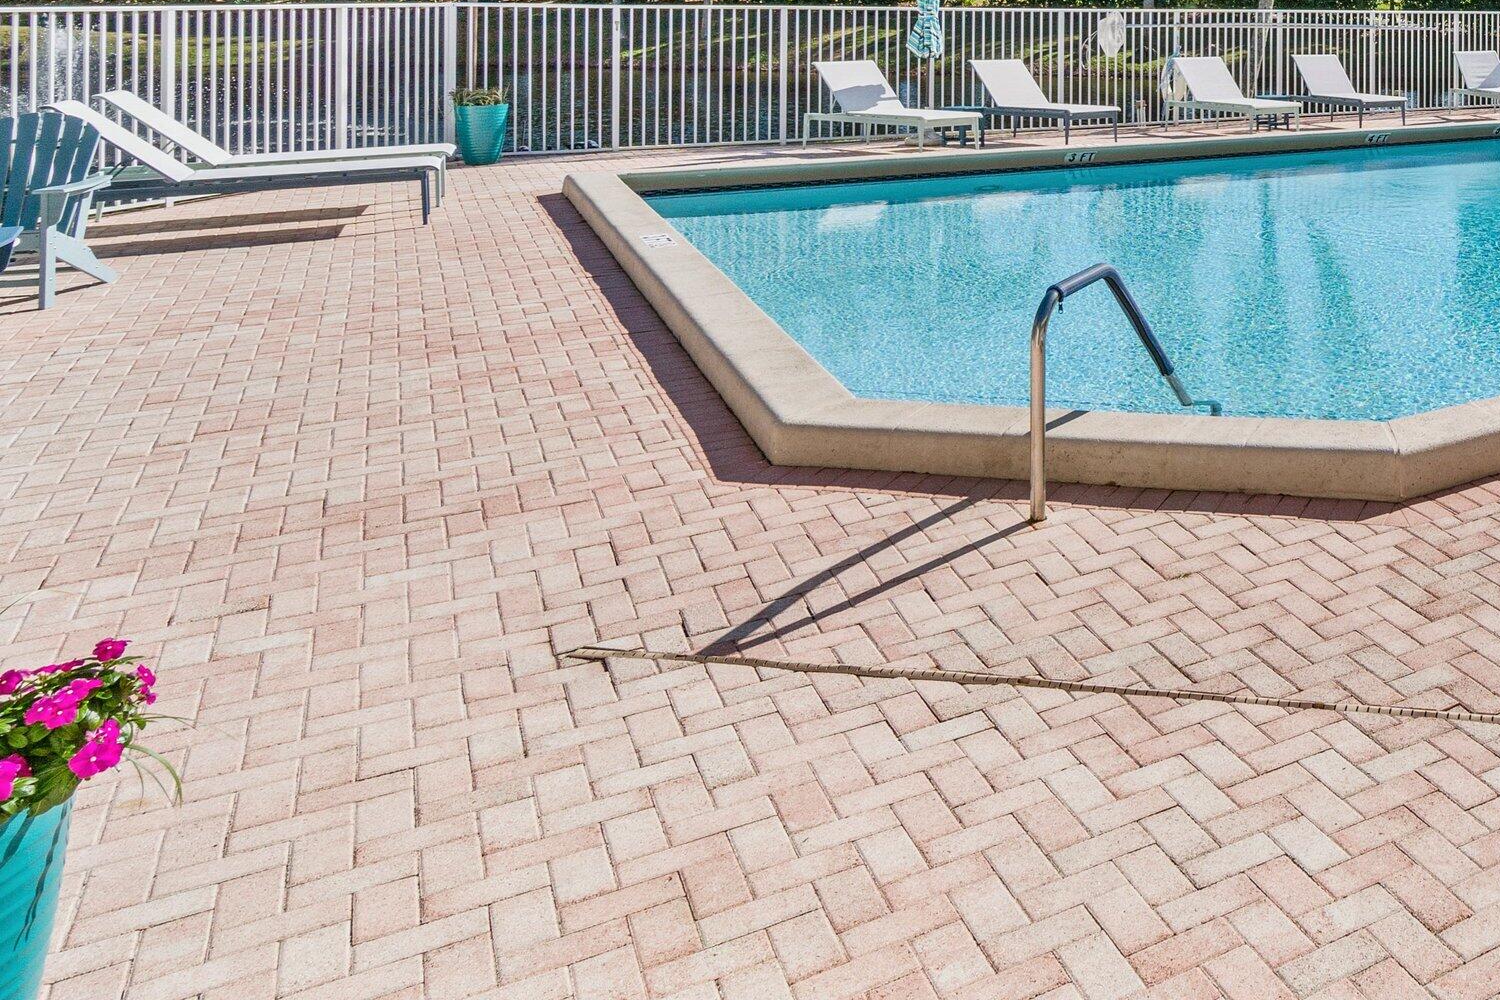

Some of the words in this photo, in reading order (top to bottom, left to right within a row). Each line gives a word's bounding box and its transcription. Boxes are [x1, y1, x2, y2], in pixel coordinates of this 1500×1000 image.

[1368, 134, 1376, 143] 4
[1376, 134, 1389, 143] FT
[1068, 152, 1077, 162] 3
[1079, 152, 1096, 162] FT
